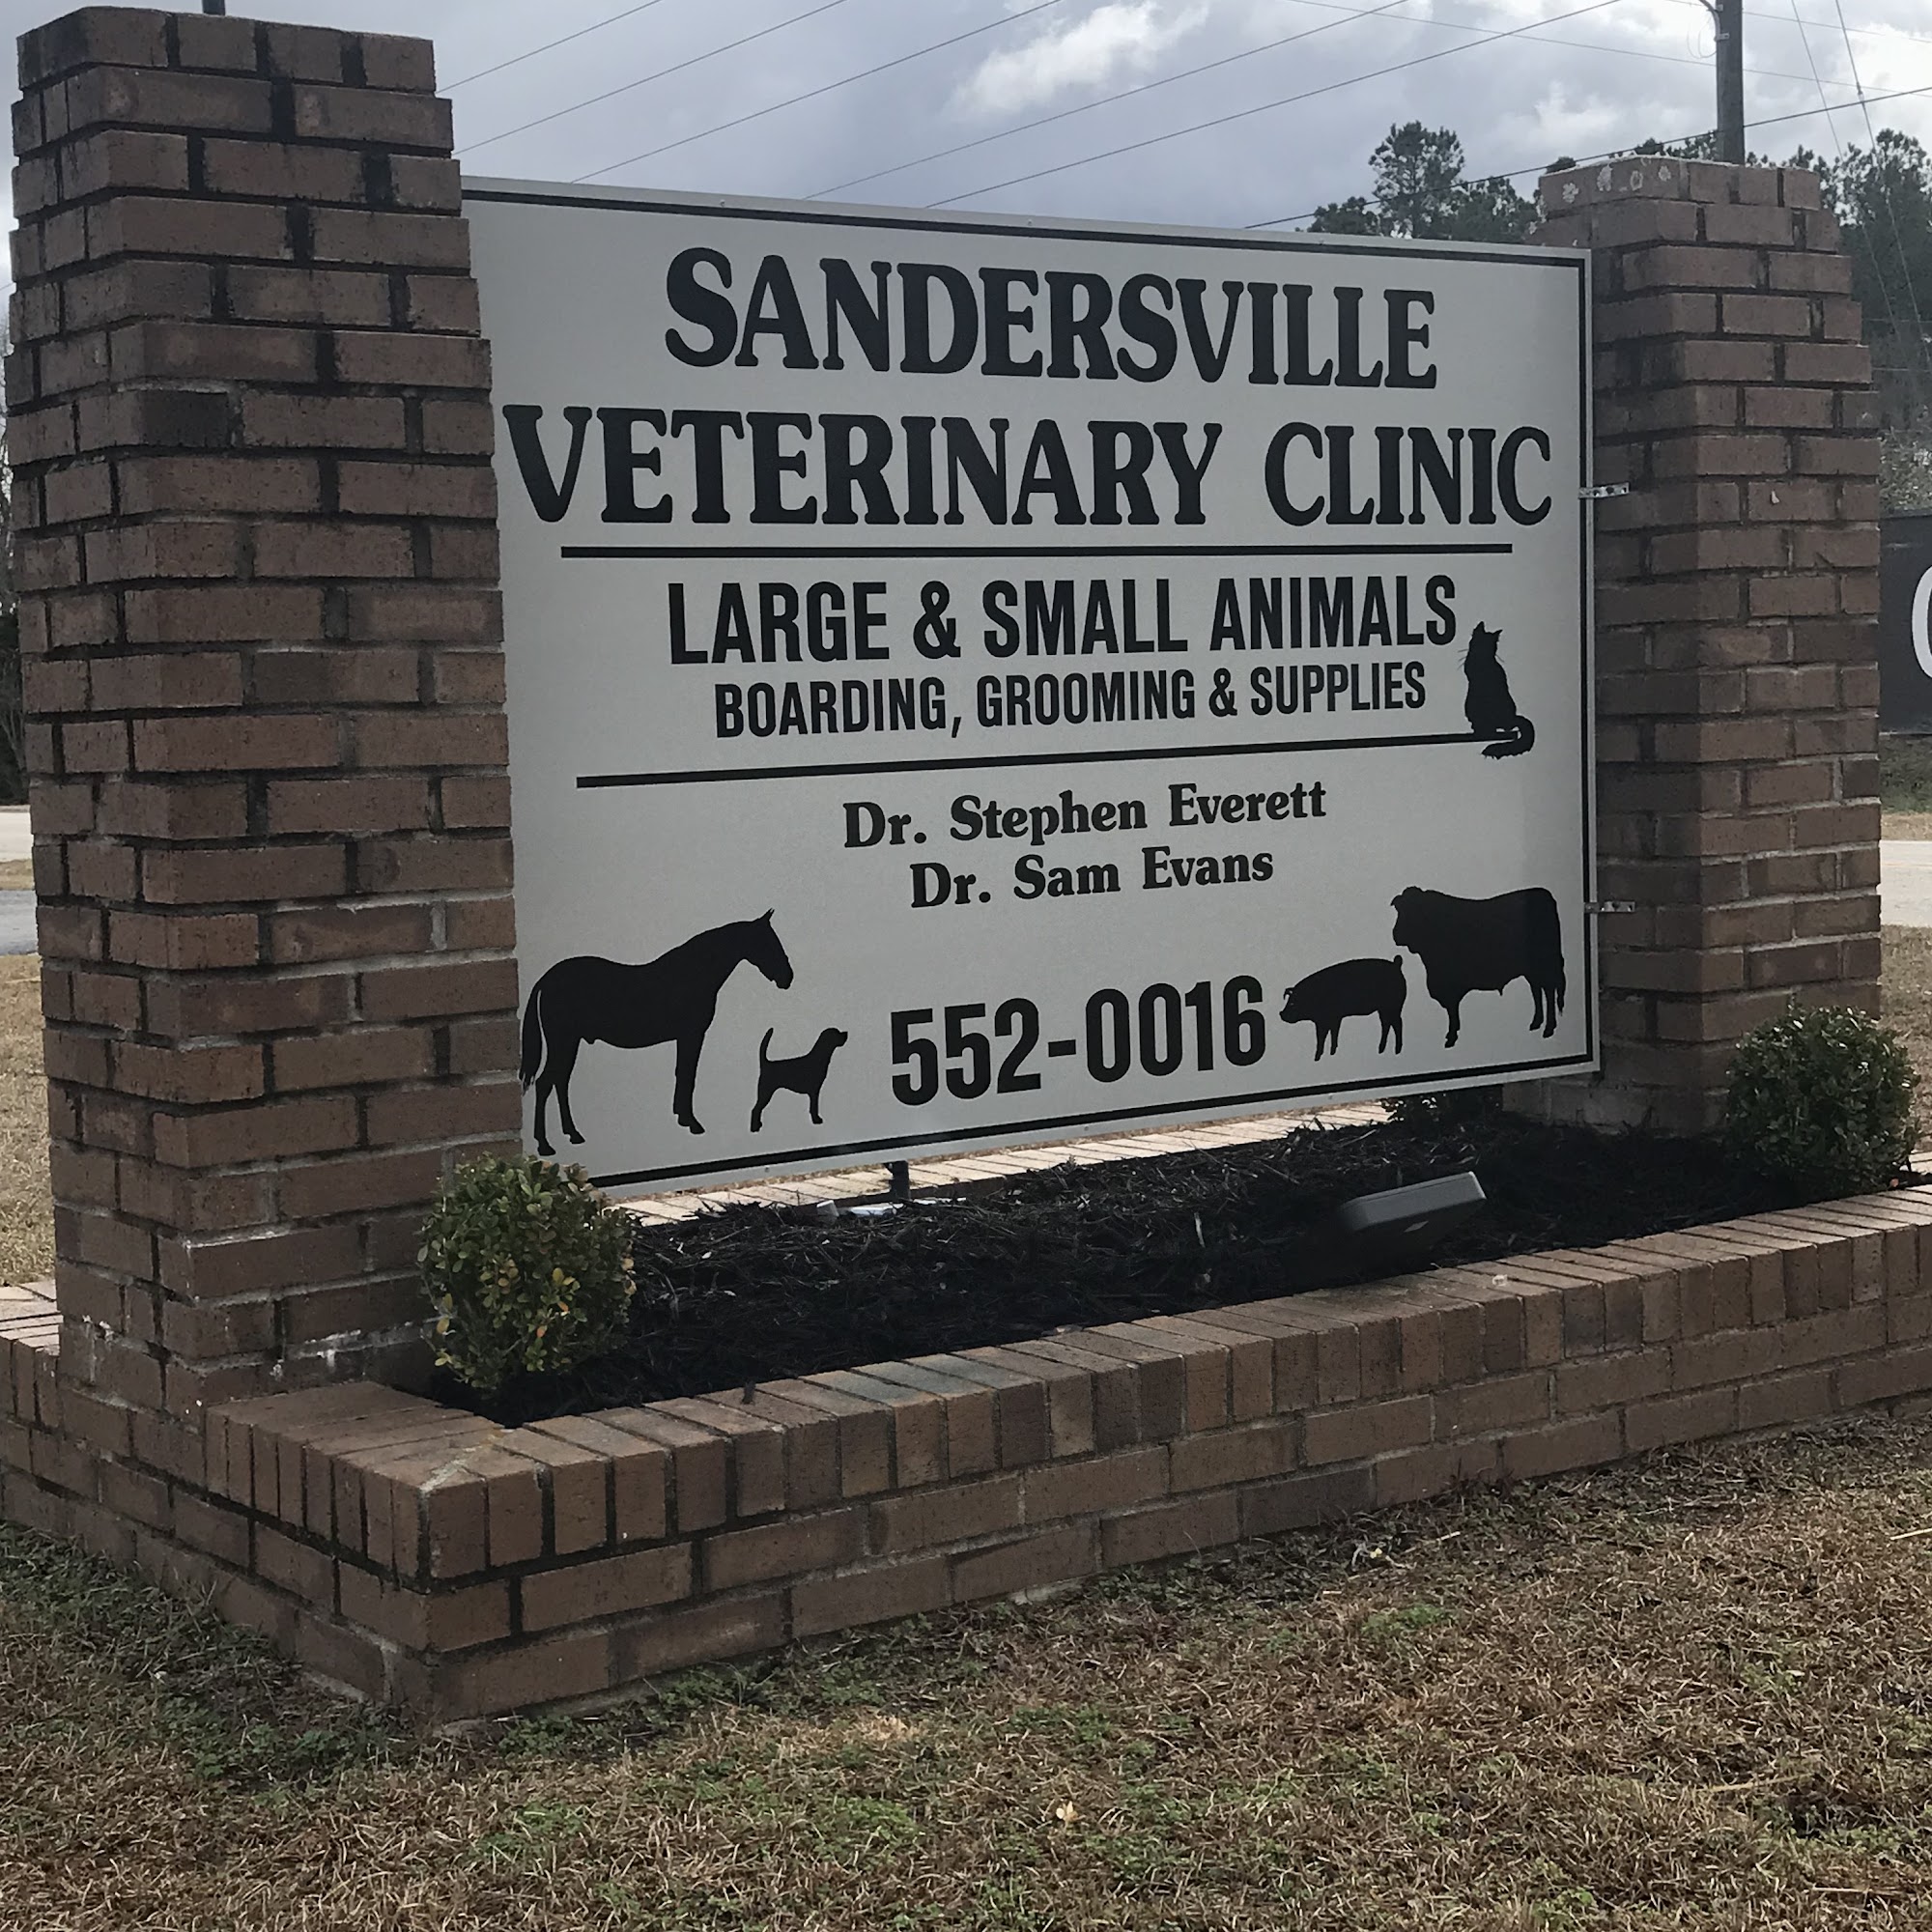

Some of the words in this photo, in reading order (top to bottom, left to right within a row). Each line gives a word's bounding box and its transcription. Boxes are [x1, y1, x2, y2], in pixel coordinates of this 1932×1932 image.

[666, 247, 1437, 388] SANDERSVILLE
[502, 404, 1222, 526] VETERINARY
[1264, 421, 1551, 526] CLINIC
[668, 581, 890, 665] LARGE
[913, 580, 961, 659] &
[982, 579, 1188, 658] SMALL
[1209, 575, 1457, 652] ANIMALS
[715, 676, 962, 739] BOARDING,
[977, 668, 1195, 728] GROOMING
[1208, 667, 1237, 717] &
[1250, 660, 1425, 716] SUPPLIES
[843, 801, 927, 848] Dr.
[950, 789, 1149, 846] Stephen
[1168, 781, 1327, 827] Everett
[909, 862, 991, 909] Dr.
[1013, 853, 1121, 899] Sam
[1141, 845, 1274, 890] Evans
[890, 975, 1266, 1107] 552-0016
